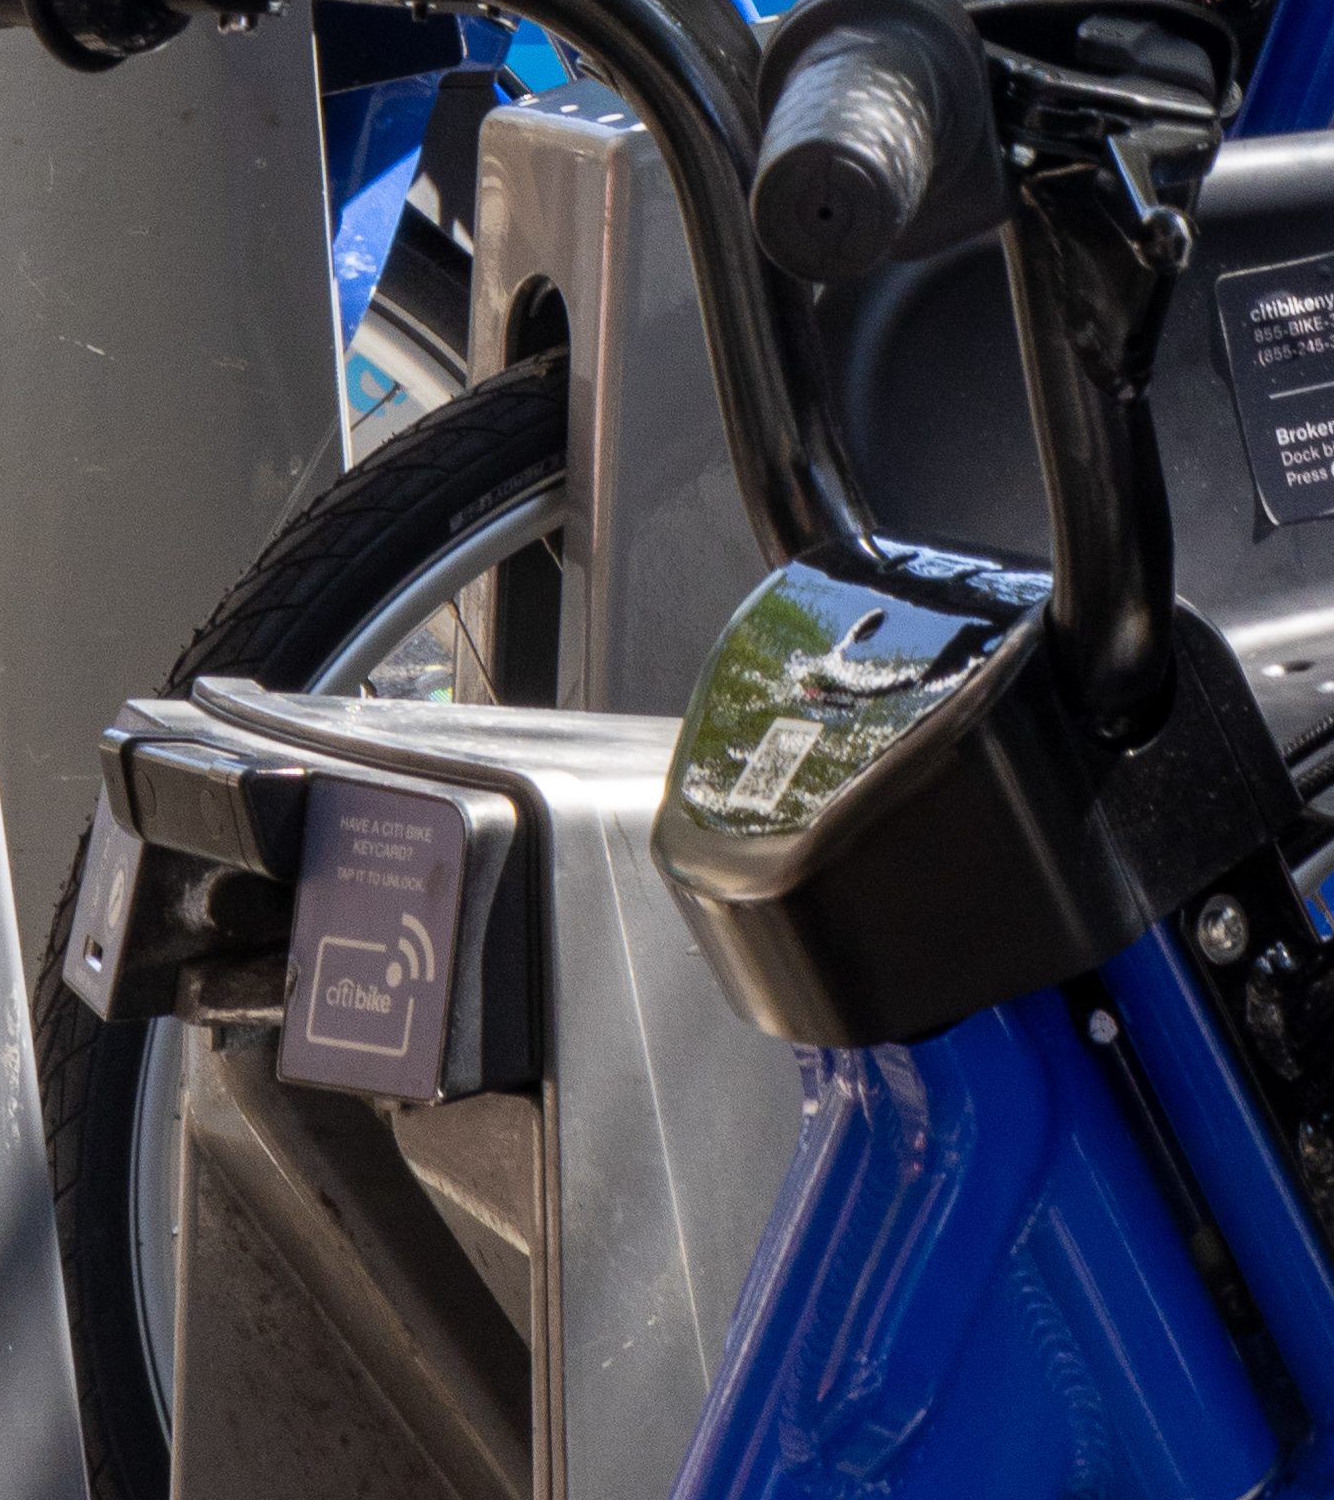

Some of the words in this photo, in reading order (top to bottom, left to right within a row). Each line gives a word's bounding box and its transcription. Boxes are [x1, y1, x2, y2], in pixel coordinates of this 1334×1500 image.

[1280, 445, 1321, 467] Dock
[1285, 468, 1329, 488] Press
[340, 816, 370, 834] HAVE
[370, 821, 380, 836] A
[382, 822, 405, 839] CITI
[406, 824, 433, 844] BIKE
[352, 838, 414, 860] KEYCARD?
[336, 866, 355, 881] TAP
[355, 868, 366, 883] IT
[367, 870, 381, 885] TO
[326, 978, 355, 1008] citi
[354, 984, 392, 1014] bike
